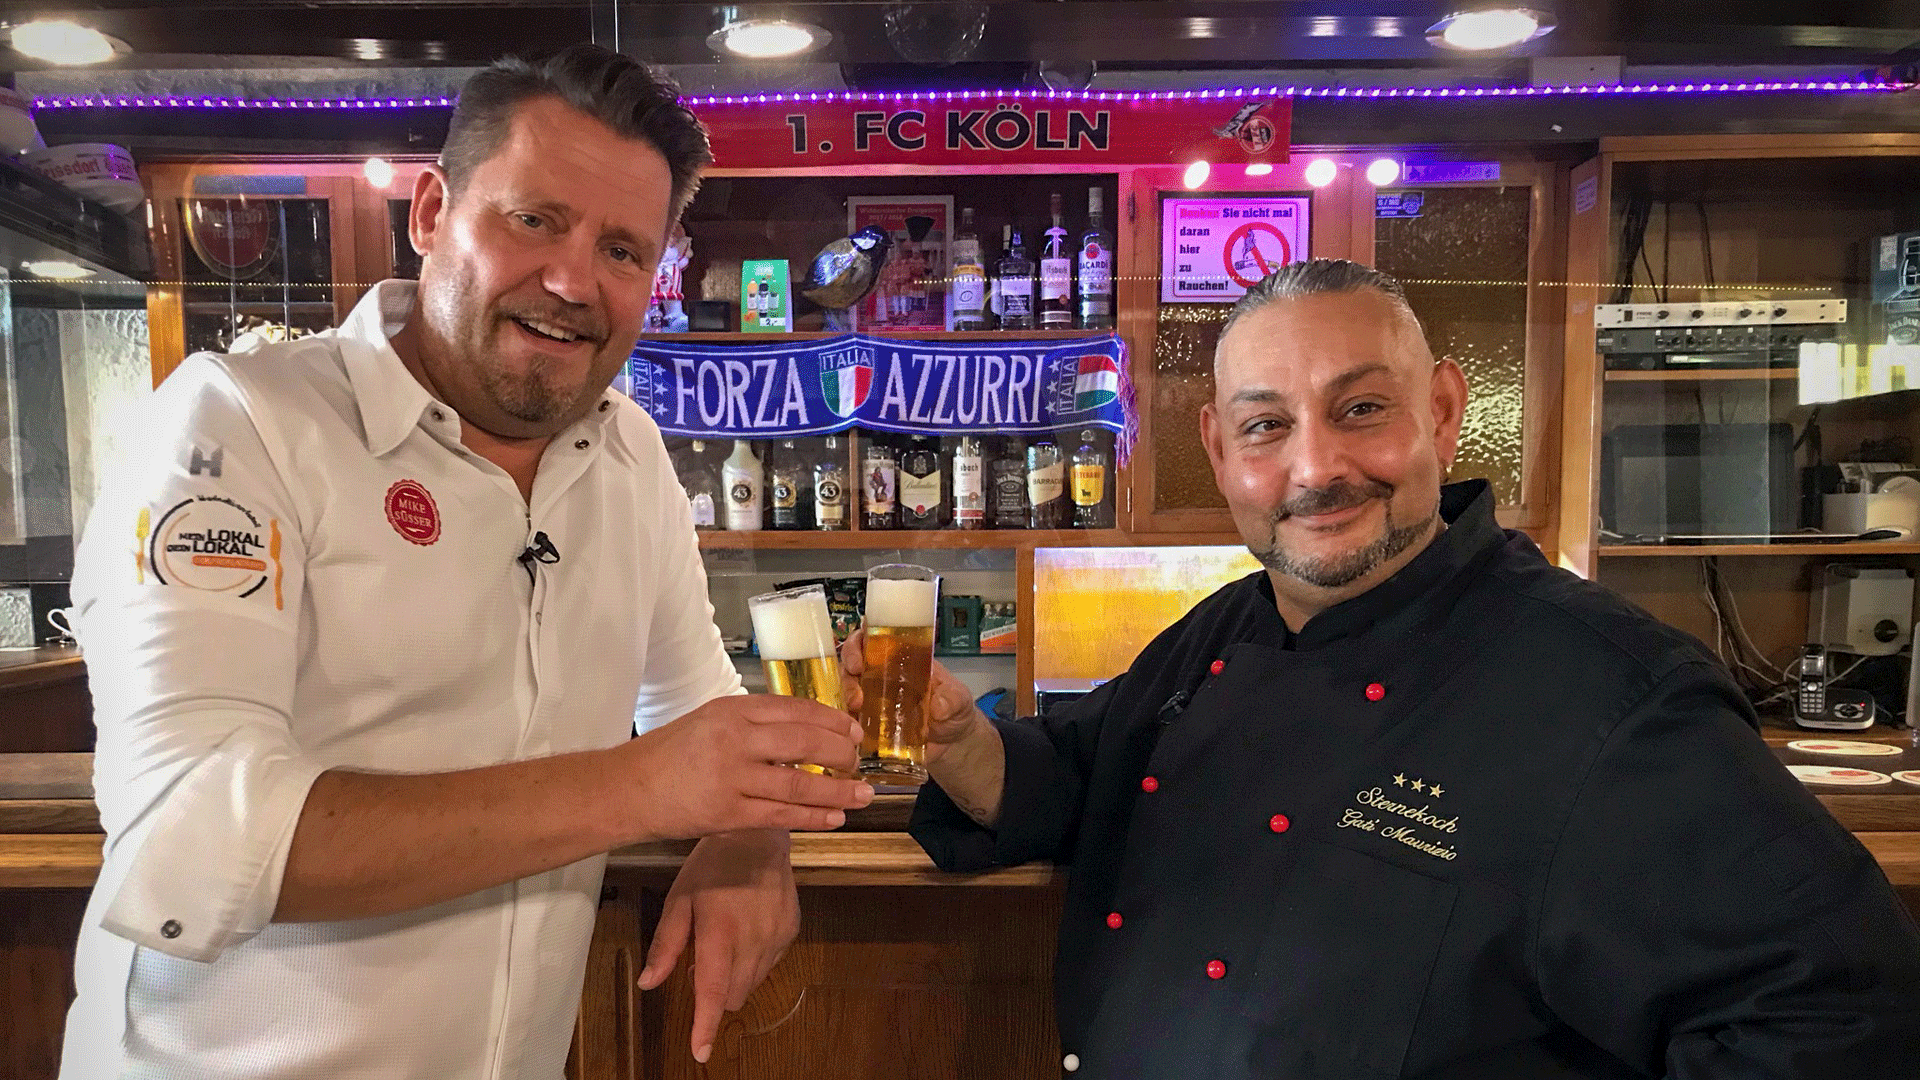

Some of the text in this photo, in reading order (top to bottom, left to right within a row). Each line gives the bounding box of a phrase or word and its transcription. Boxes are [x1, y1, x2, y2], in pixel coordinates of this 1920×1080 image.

[785, 102, 1111, 154] 1. FC KÖLN
[1222, 208, 1240, 218] Sie
[1242, 208, 1270, 218] nicht
[1272, 208, 1293, 218] mal
[1179, 226, 1210, 236] daran
[1179, 244, 1201, 254] hier
[1178, 280, 1229, 291] Rauchen!
[821, 348, 872, 371] ITALIA
[671, 357, 811, 429] FORZA
[877, 351, 1047, 425] AZZURRI
[1058, 358, 1078, 413] ITALIA
[733, 487, 748, 499] 43
[774, 487, 788, 499] 43
[820, 485, 837, 497] 43
[399, 498, 426, 514] MIKE
[394, 510, 433, 528] SÜSSER
[207, 528, 265, 549] LOKAL
[192, 540, 254, 557] LOKAL
[1356, 786, 1459, 833] Sternekoch
[1336, 808, 1457, 861] Gati Maurizio
